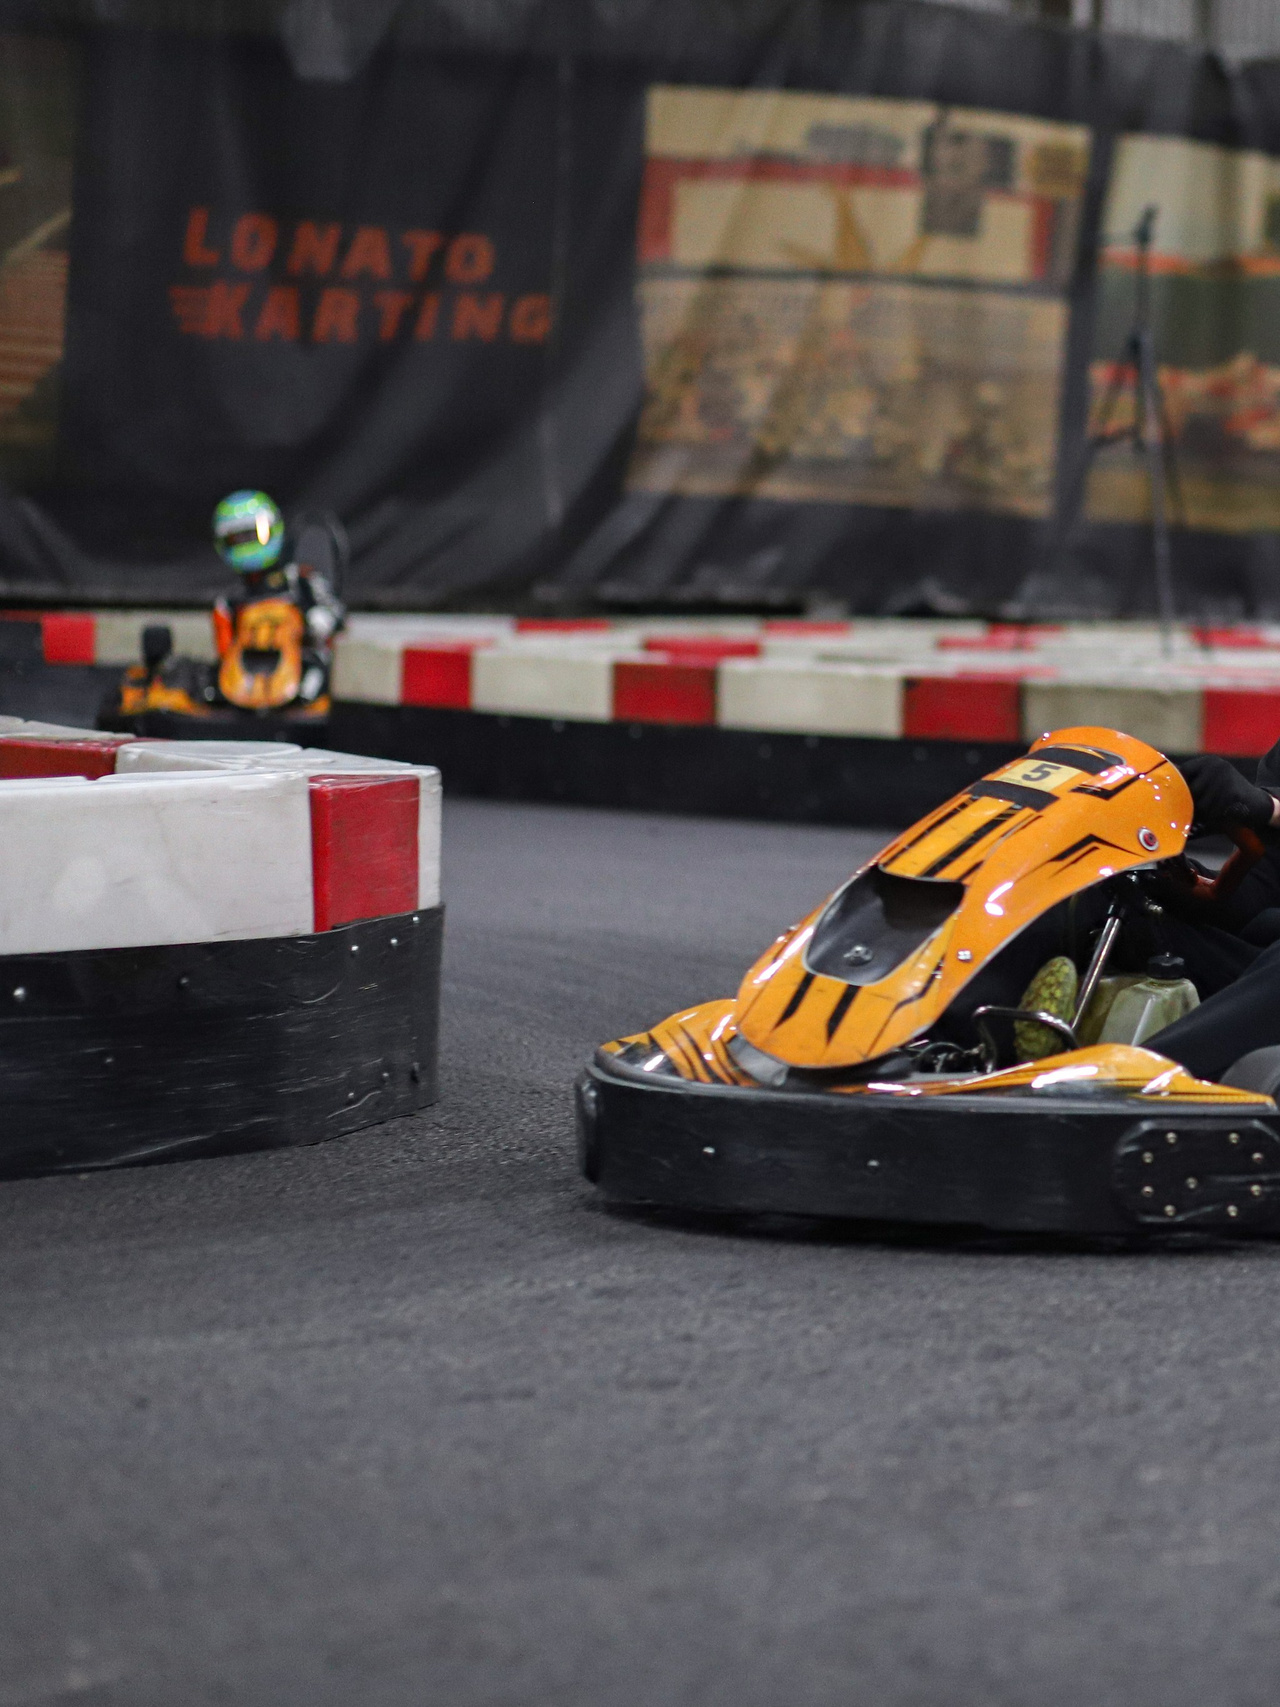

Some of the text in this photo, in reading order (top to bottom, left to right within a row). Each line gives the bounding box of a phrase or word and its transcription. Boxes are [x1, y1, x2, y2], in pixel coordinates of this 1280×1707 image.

[182, 206, 497, 284] LONATO
[196, 280, 553, 344] KARTING
[1021, 763, 1062, 782] 5
